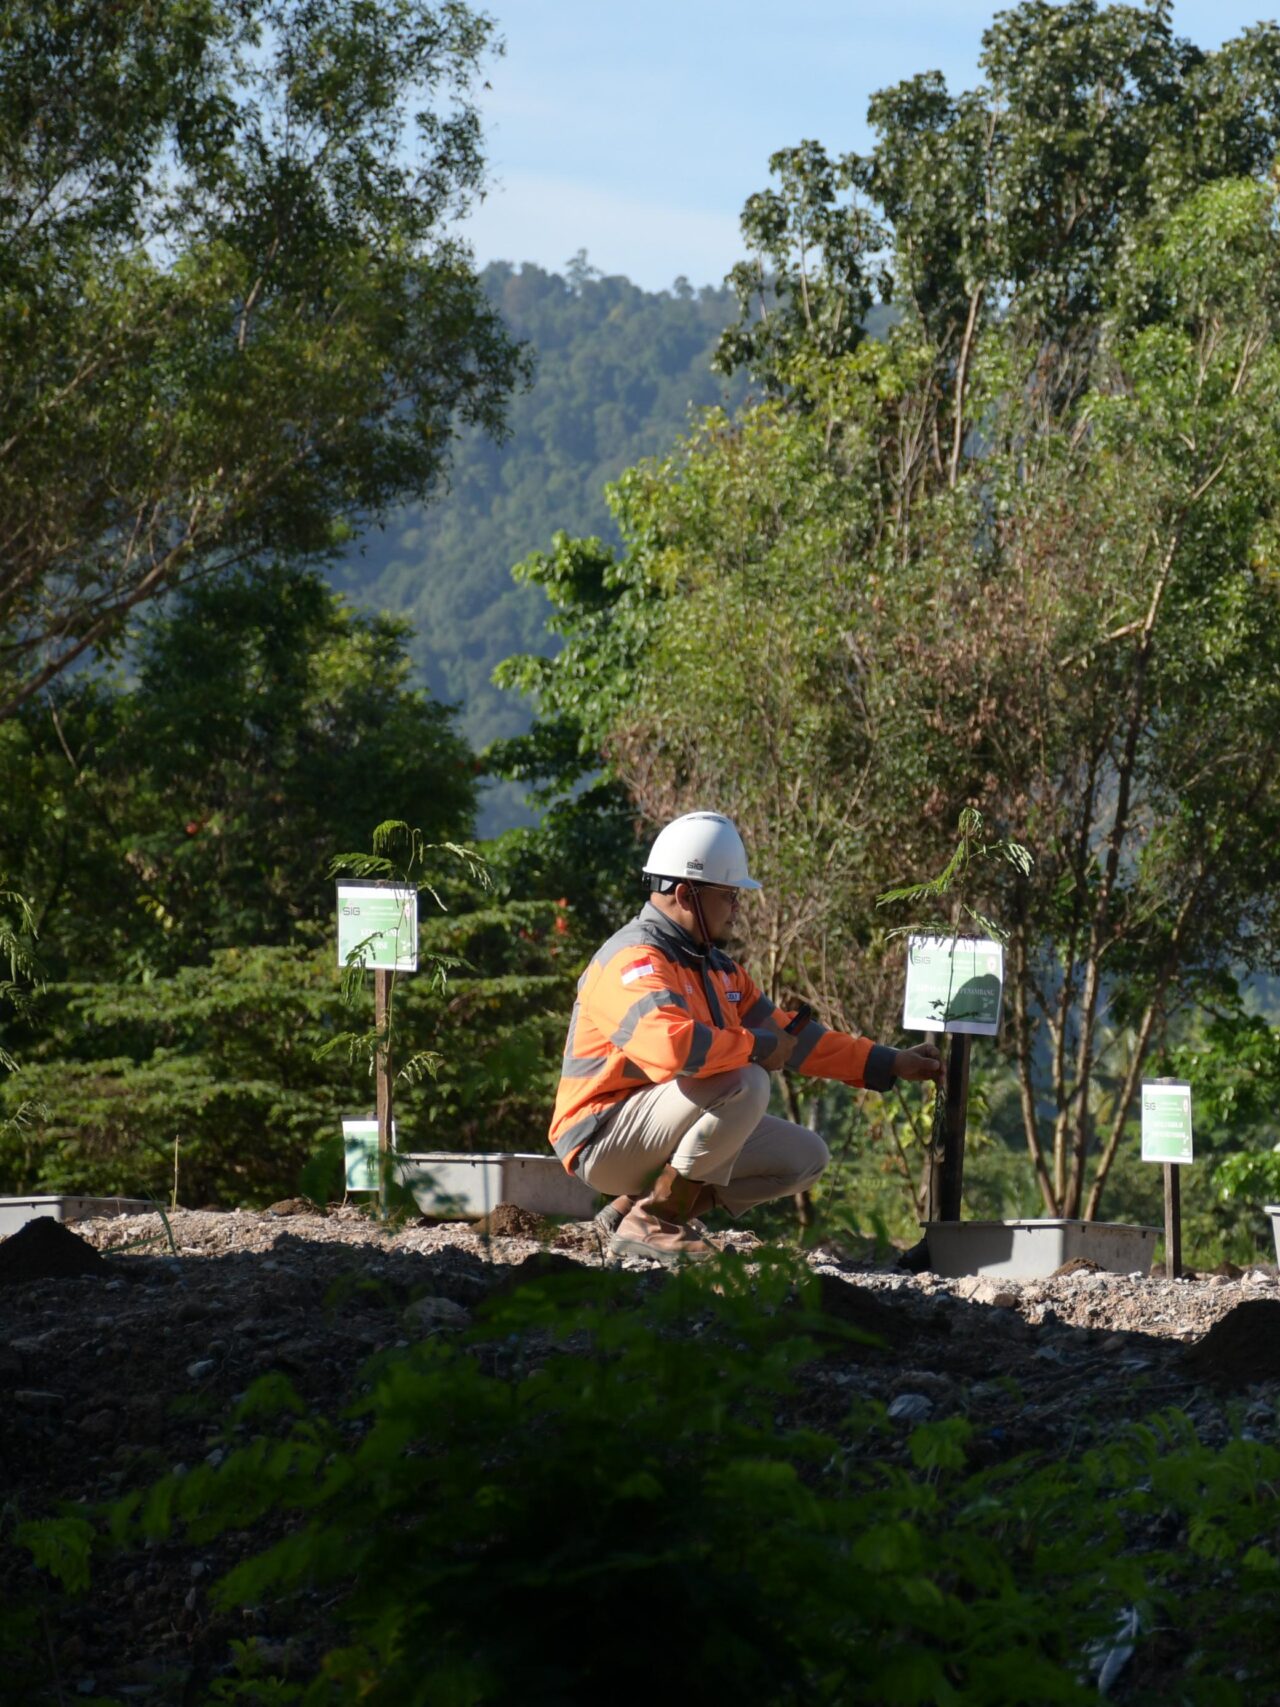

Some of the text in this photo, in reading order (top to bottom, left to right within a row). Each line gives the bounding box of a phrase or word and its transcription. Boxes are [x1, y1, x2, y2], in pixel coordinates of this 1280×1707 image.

[687, 861, 704, 870] SIG
[343, 907, 360, 916] SIG
[914, 956, 931, 965] SIG
[1145, 1102, 1157, 1111] SIG
